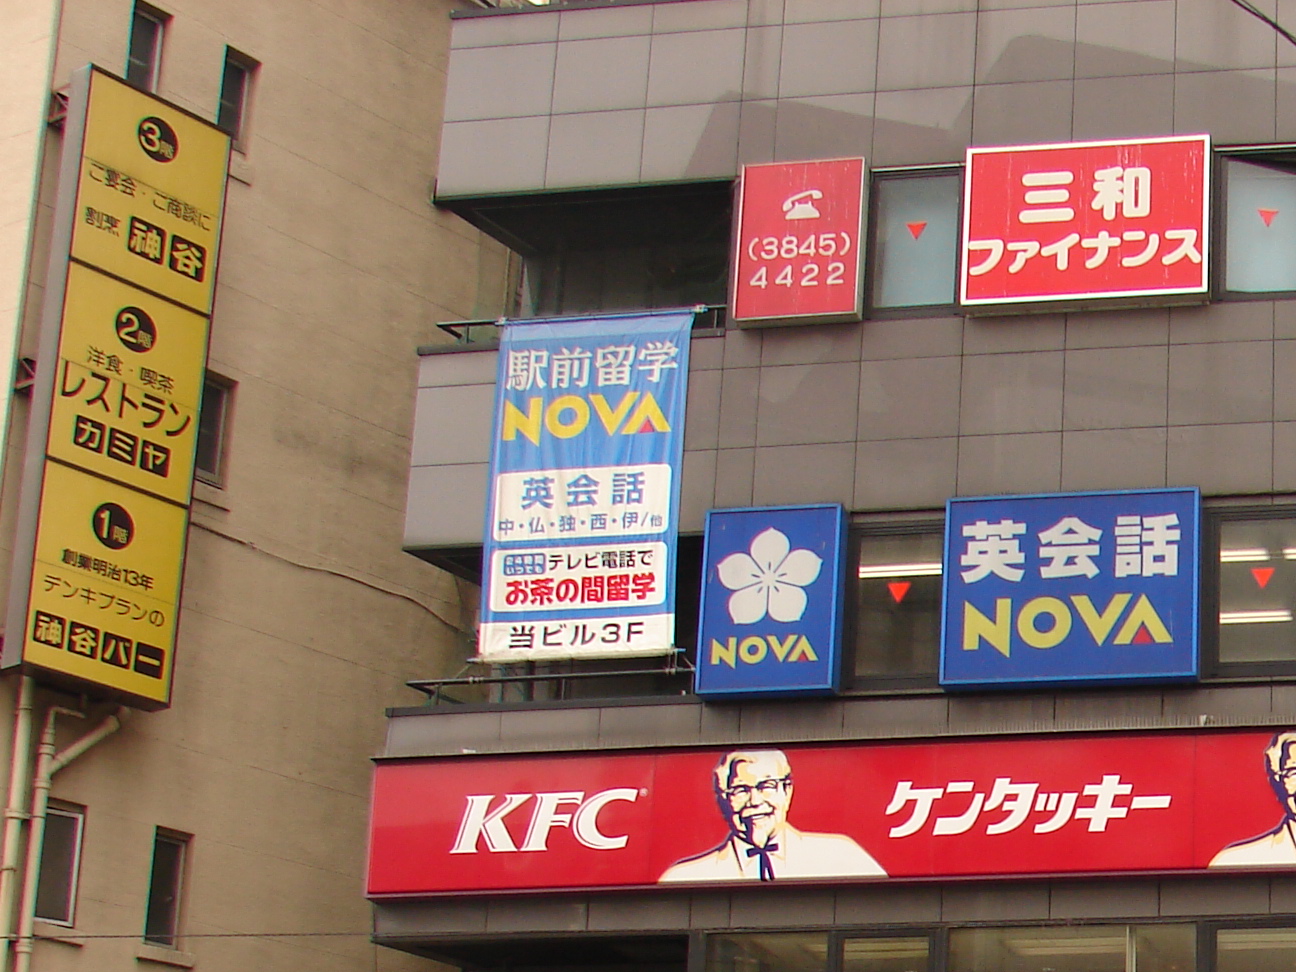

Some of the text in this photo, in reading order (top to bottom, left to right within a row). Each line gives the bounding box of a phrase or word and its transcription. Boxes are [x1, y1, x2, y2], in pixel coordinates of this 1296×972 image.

[1018, 165, 1151, 226] 三和
[129, 219, 206, 280] 神谷
[747, 231, 851, 262] (3845)
[968, 227, 1203, 277] ファイナンス
[749, 261, 846, 290] 4422
[87, 346, 174, 393] 洋食・喫茶
[505, 340, 679, 391] 駅前留学
[61, 361, 191, 437] レストラン
[502, 391, 671, 446] NOVA
[74, 415, 169, 477] カミヤ
[521, 471, 645, 510] 英会話
[61, 548, 153, 592] 創業明治13年
[549, 550, 654, 572] テレビ電話で
[960, 513, 1182, 584] 英会話
[43, 573, 165, 628] デンキブランの
[505, 572, 656, 606] お茶の間留学
[34, 612, 163, 679] 神谷バー
[509, 622, 644, 650] 当ビル3F
[711, 634, 818, 669] NOVA
[963, 592, 1174, 659] NOVA
[449, 788, 641, 855] KFC
[885, 774, 1171, 838] ケンタッキー
